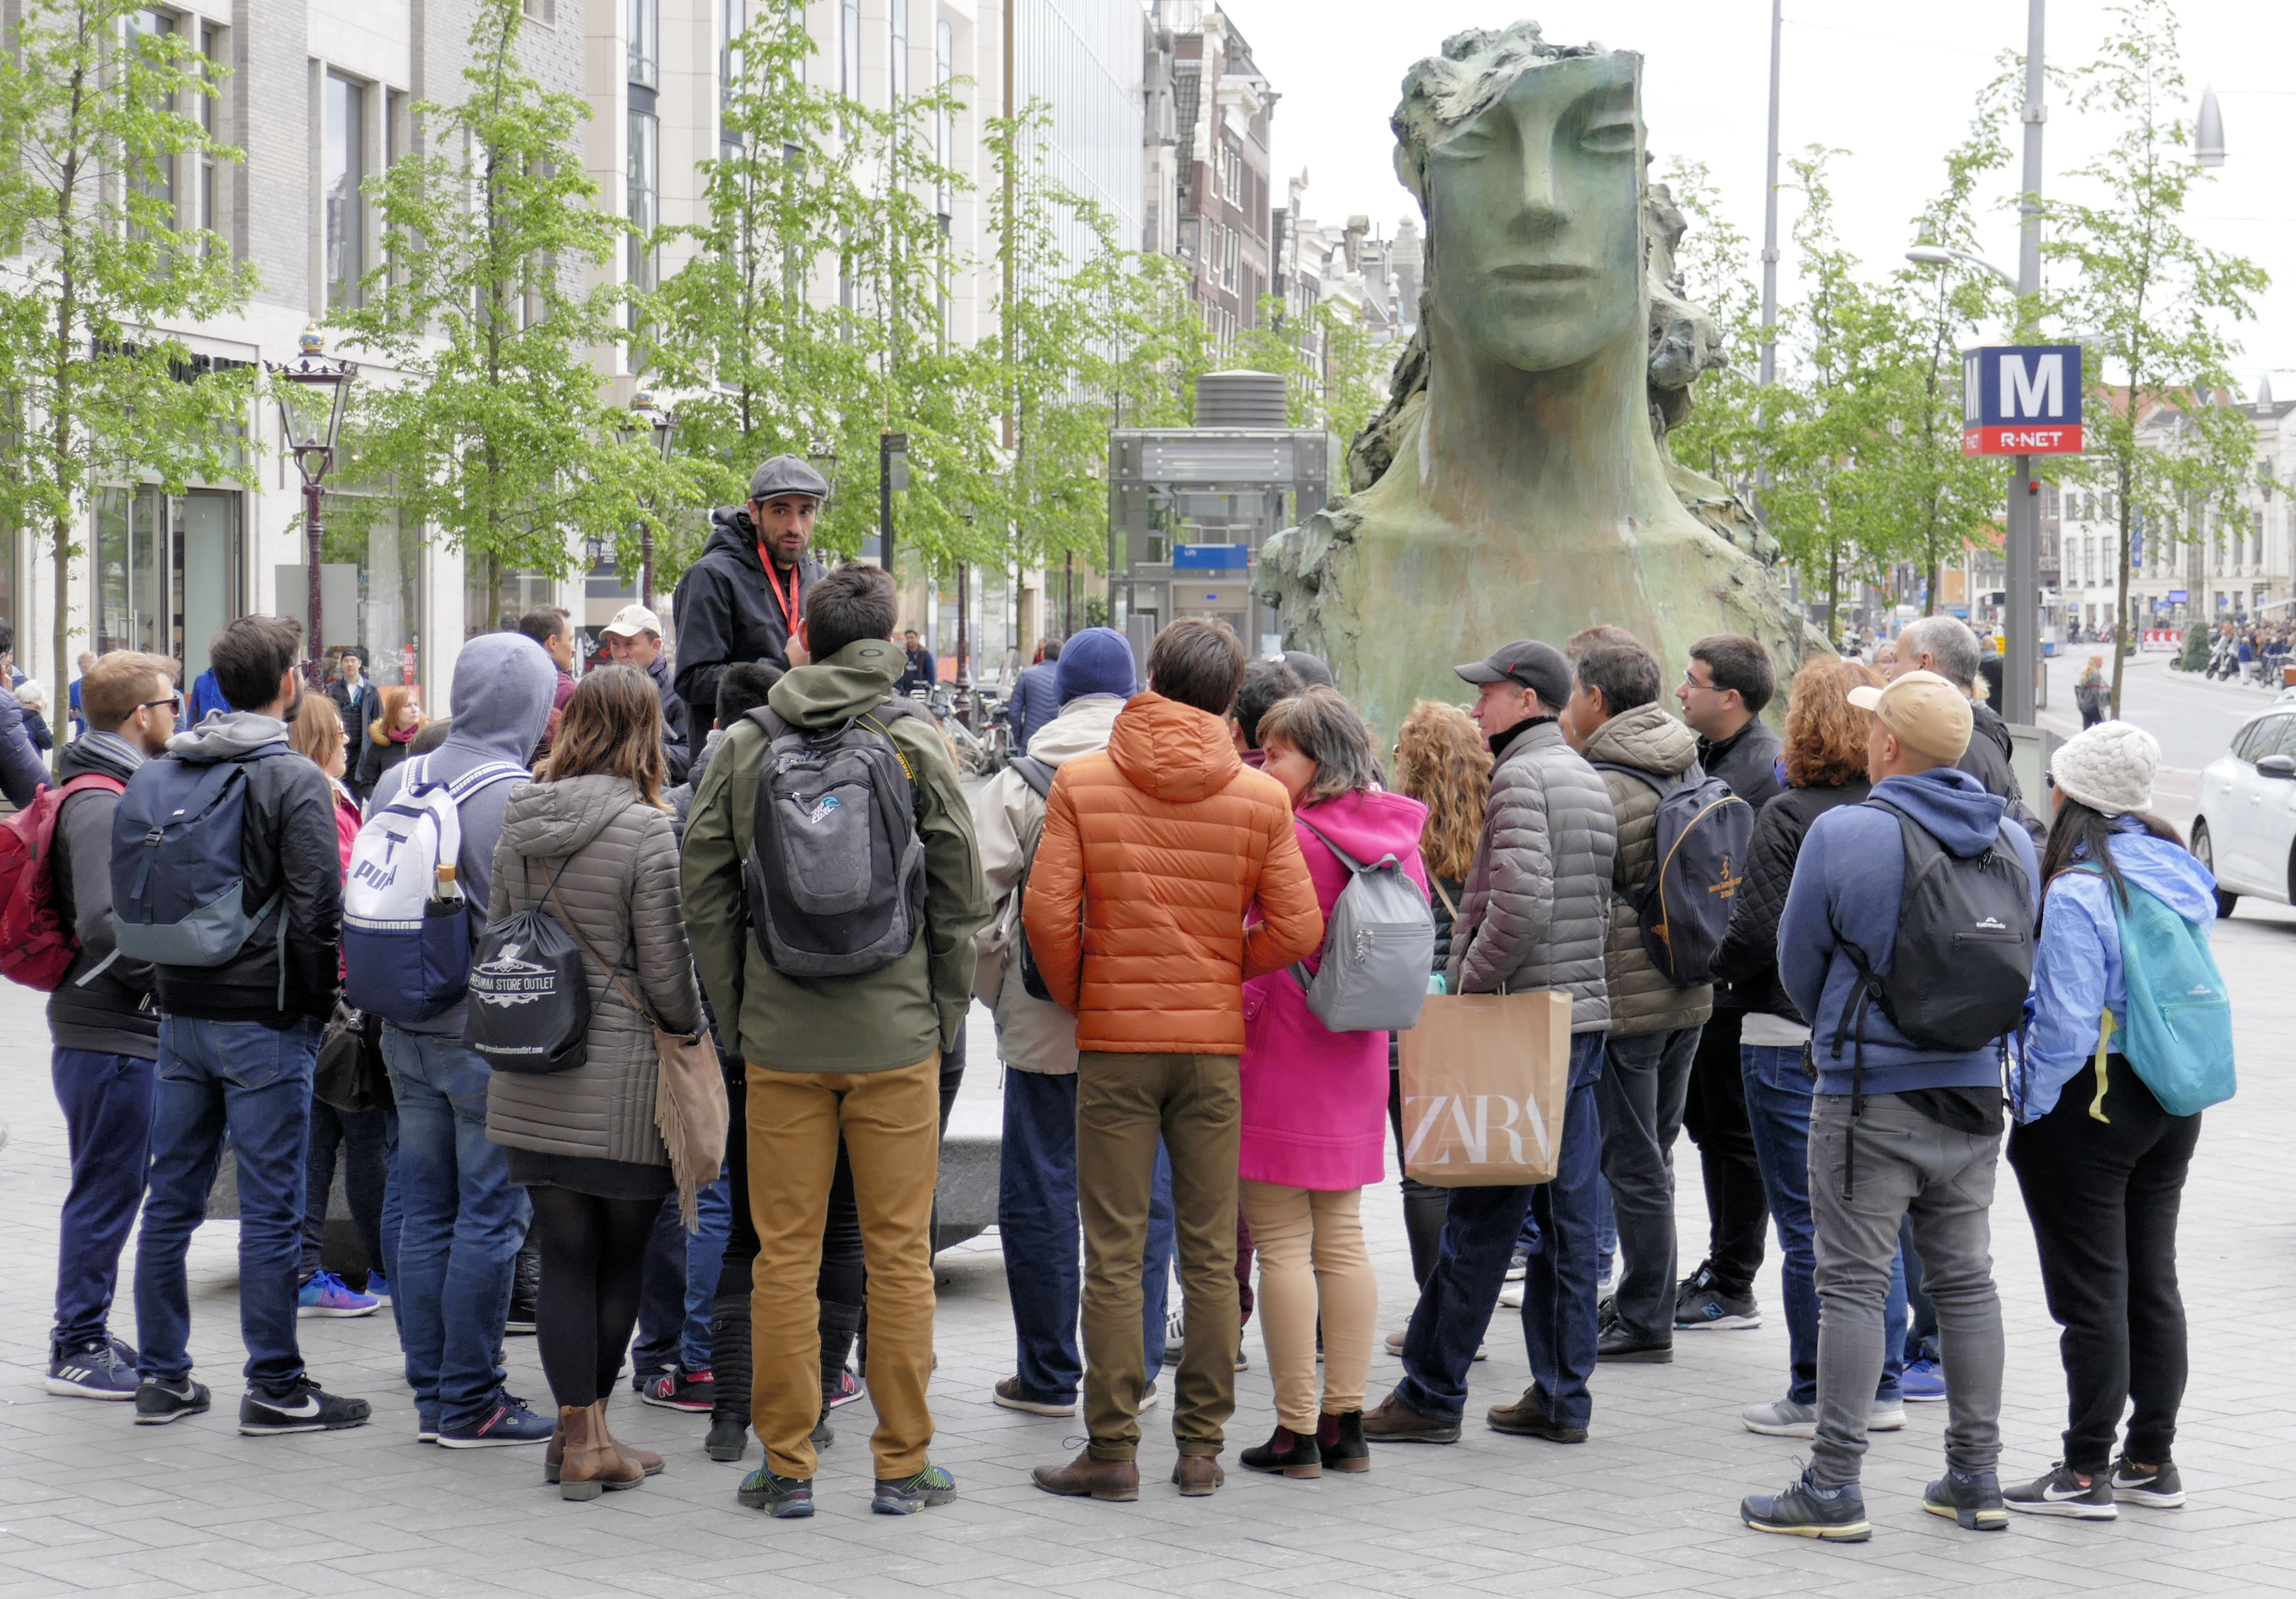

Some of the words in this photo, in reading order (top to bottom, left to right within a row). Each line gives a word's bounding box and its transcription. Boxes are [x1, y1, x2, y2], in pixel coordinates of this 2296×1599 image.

[1965, 357, 1979, 422] M
[1999, 353, 2064, 418] M
[469, 972, 494, 990] PREMIUM
[497, 978, 522, 991] STORE
[523, 976, 555, 990] OUTLET
[1405, 1092, 1550, 1165] ZARA
[658, 1375, 675, 1399] N
